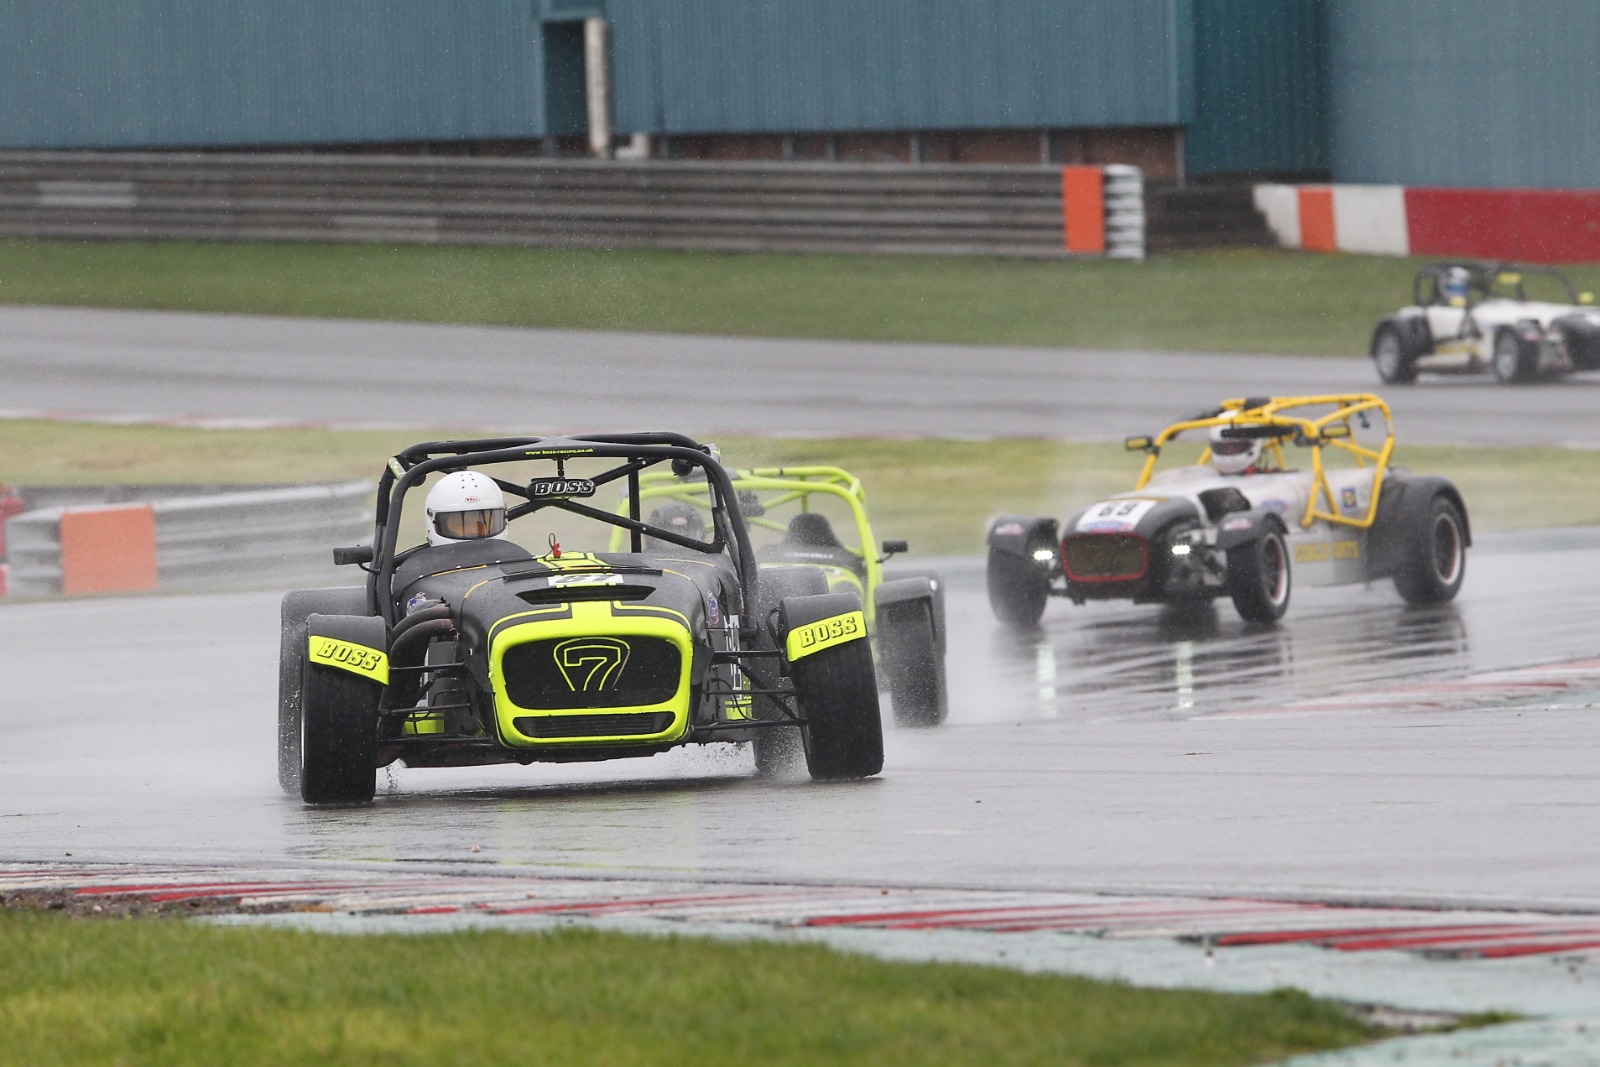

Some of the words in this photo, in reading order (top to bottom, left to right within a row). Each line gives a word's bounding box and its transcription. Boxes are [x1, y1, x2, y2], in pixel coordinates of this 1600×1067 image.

[535, 481, 594, 496] BOSS
[798, 617, 858, 648] BOSS
[317, 641, 382, 671] BOSS
[564, 644, 621, 691] 7
